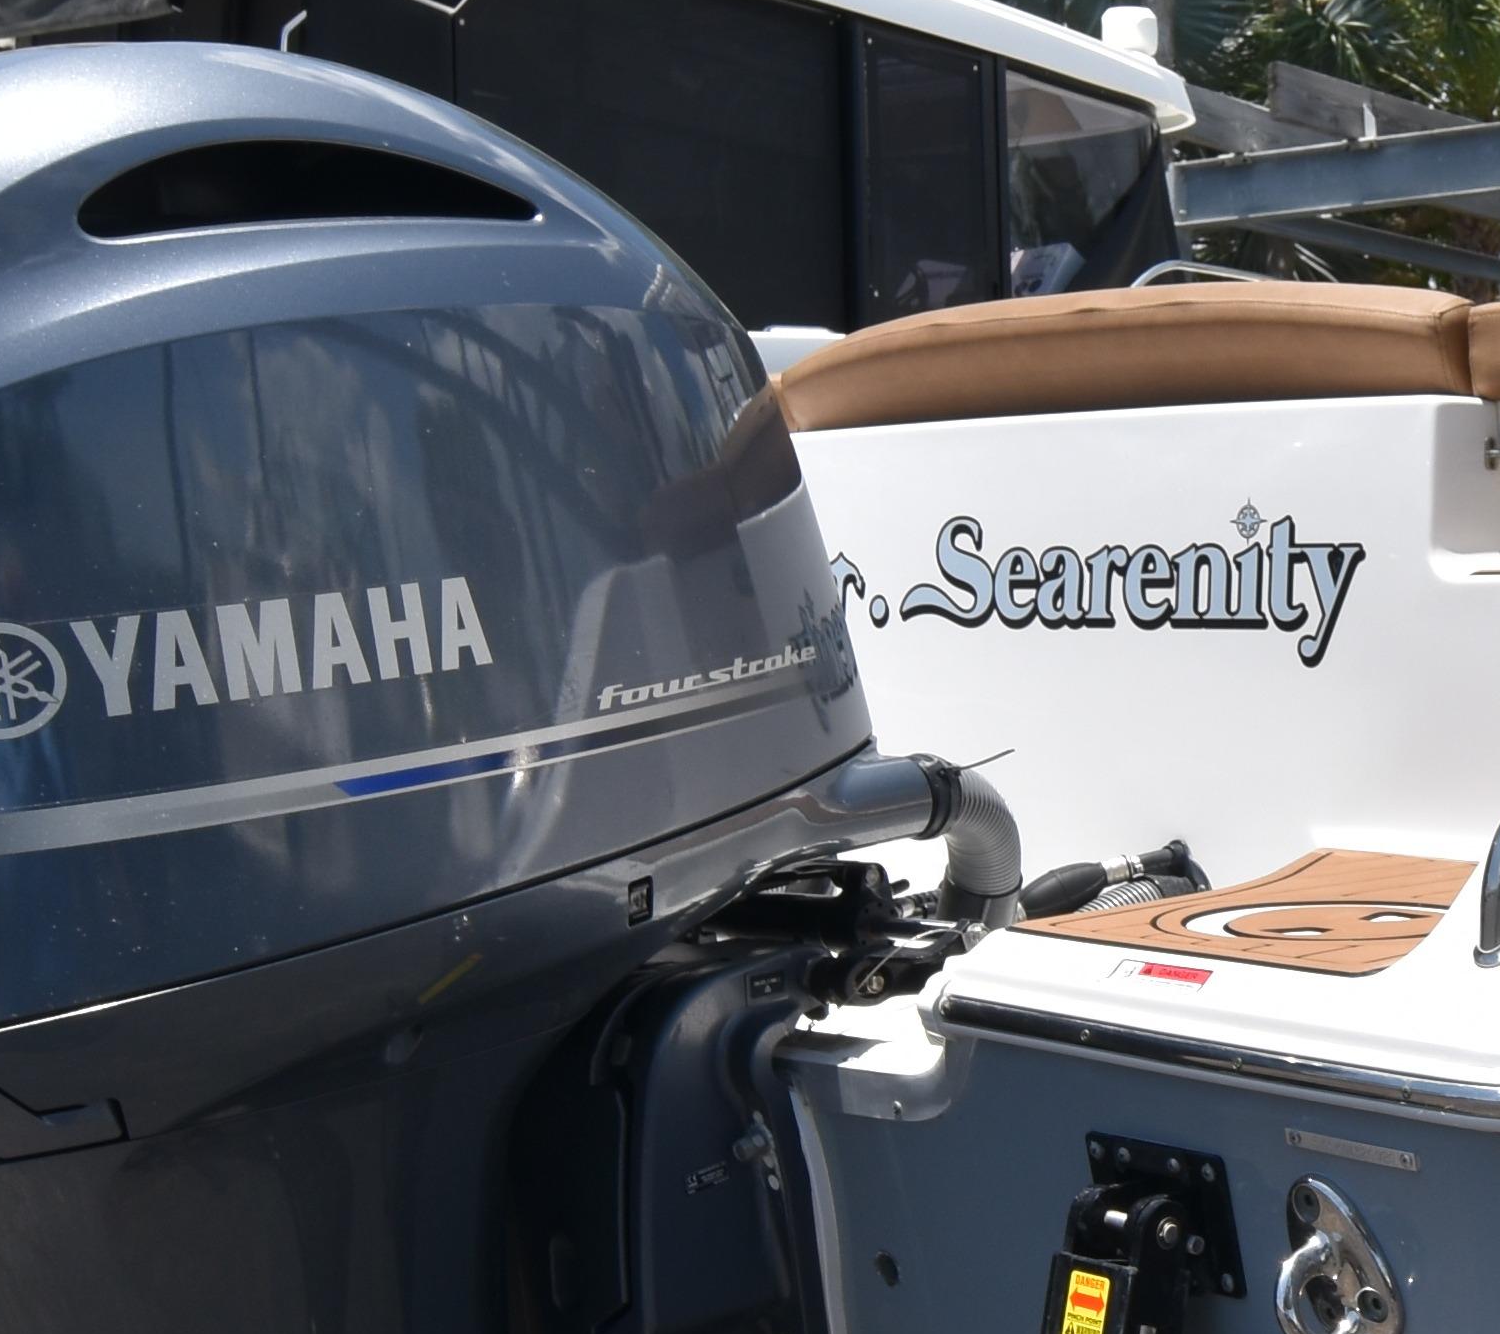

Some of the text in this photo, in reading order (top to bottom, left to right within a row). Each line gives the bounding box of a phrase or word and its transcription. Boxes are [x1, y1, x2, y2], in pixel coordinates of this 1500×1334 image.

[71, 577, 493, 718] YAMAHA
[901, 509, 1365, 668] Searenity
[1075, 1274, 1105, 1291] DANGER
